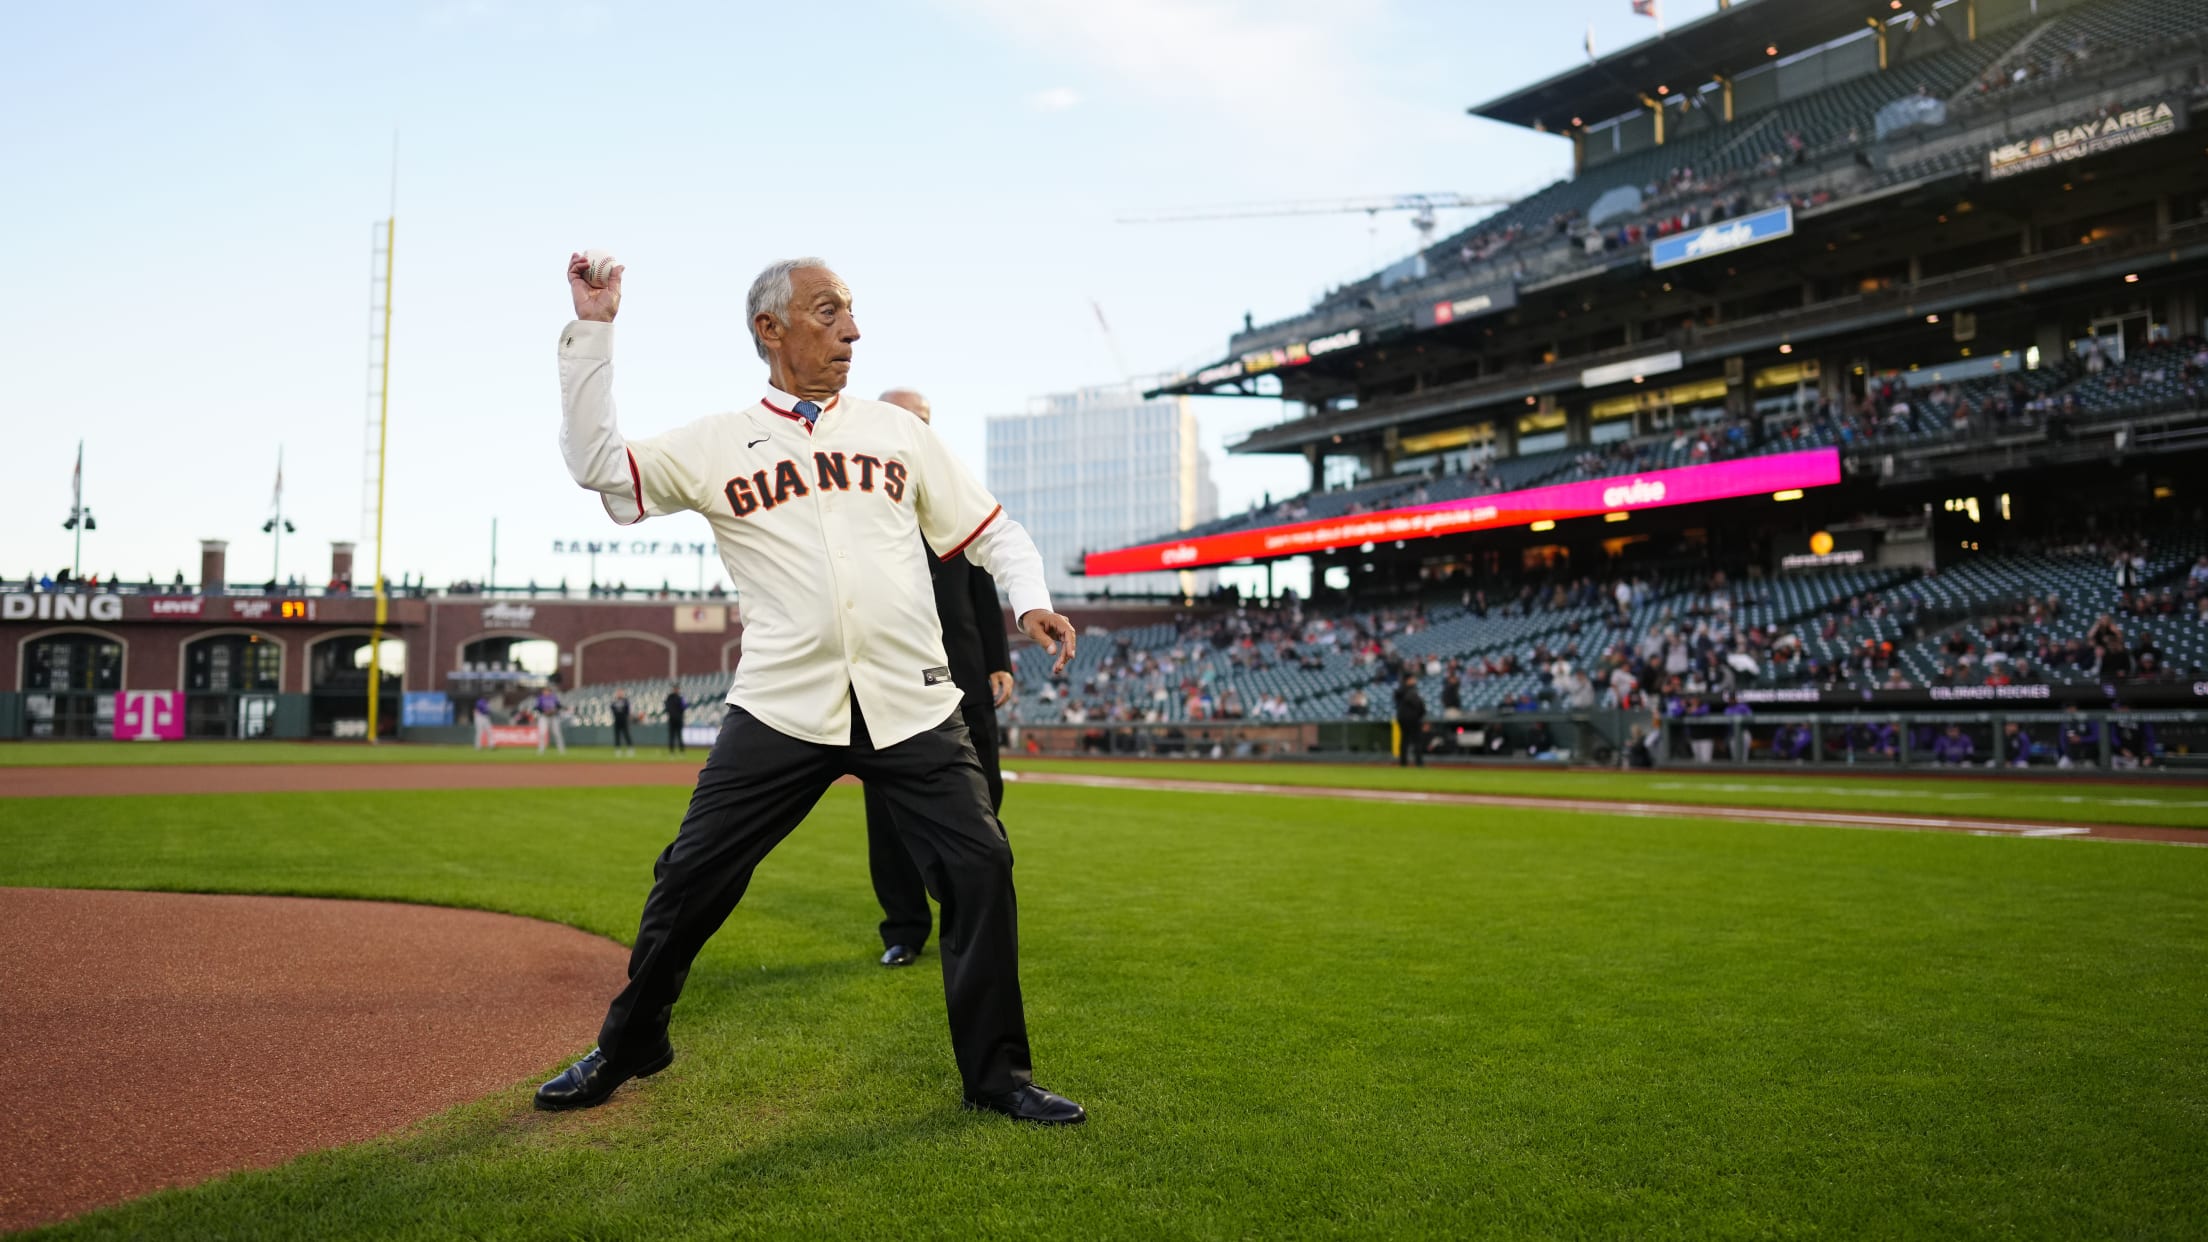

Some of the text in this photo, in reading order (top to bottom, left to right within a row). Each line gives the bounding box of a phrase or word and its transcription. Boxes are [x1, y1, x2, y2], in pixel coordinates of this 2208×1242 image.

[1989, 102, 2174, 165] NBC BAY AREA
[2052, 144, 2088, 163] YOU
[724, 452, 907, 517] GIANTS
[1603, 478, 1666, 507] cruise
[553, 540, 621, 554] BANK
[630, 541, 660, 554] OF
[2, 593, 123, 620] DING
